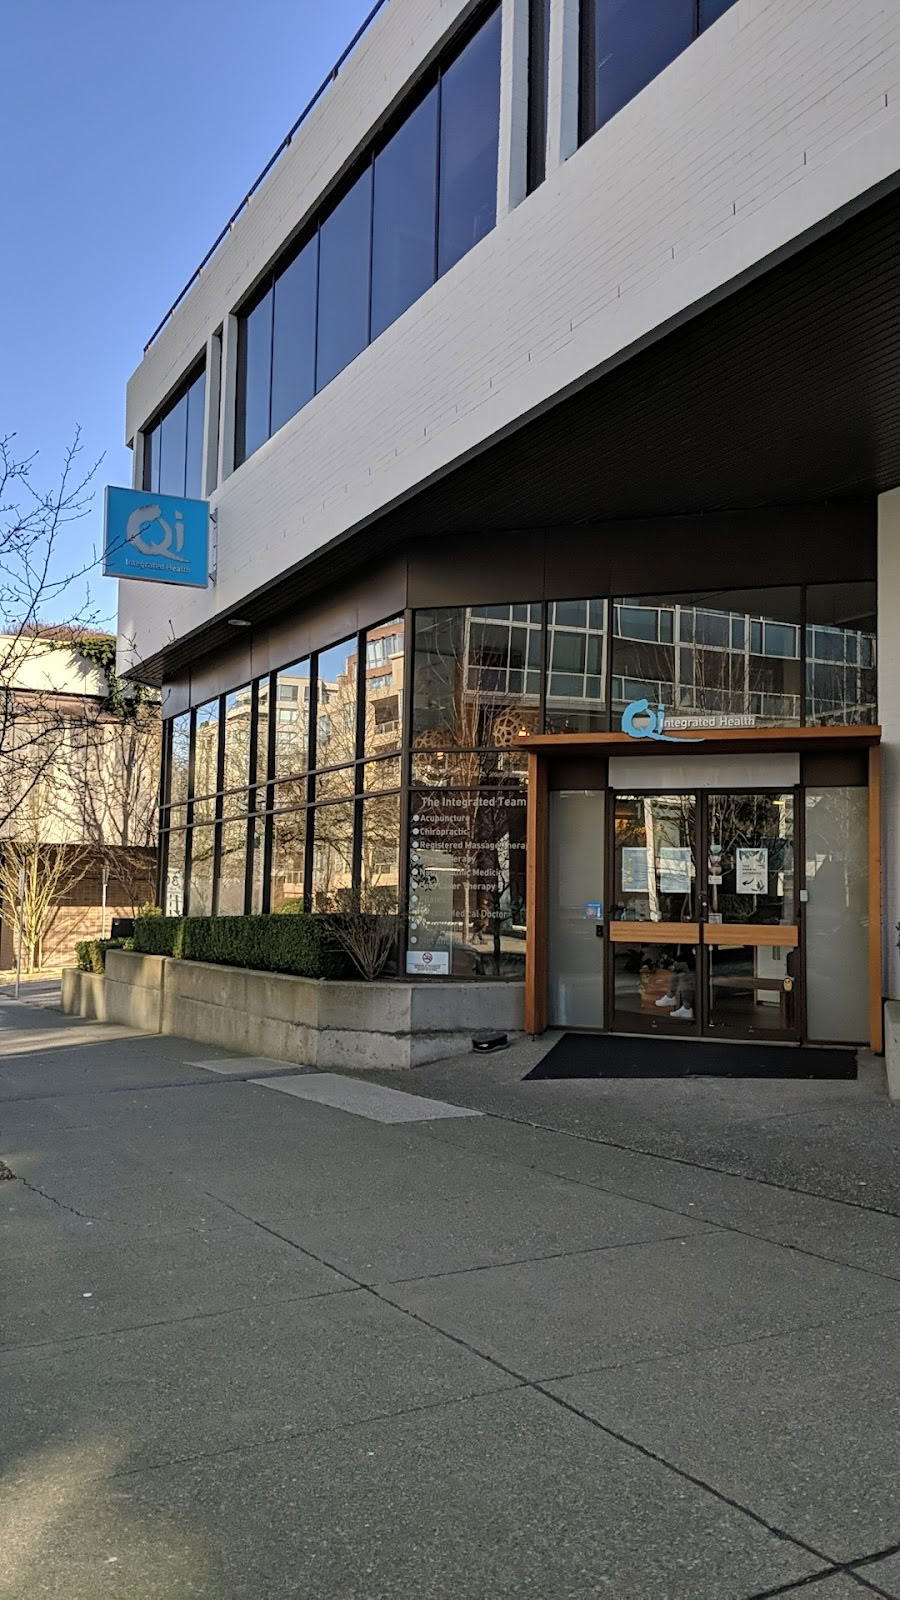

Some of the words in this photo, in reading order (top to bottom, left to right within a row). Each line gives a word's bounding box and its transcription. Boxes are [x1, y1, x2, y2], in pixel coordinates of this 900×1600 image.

[126, 504, 192, 563] Qi
[125, 558, 165, 570] Integrated
[166, 564, 192, 573] Health
[621, 699, 705, 742] Qi
[660, 717, 716, 729] Integrated
[719, 716, 755, 726] Health
[421, 797, 440, 807] The
[442, 797, 496, 809] Integrated
[498, 797, 527, 807] Team
[420, 814, 470, 824] Acupuncture
[420, 827, 468, 837] Chiropractic
[420, 841, 463, 851] Registered
[481, 909, 507, 919] Doctor
